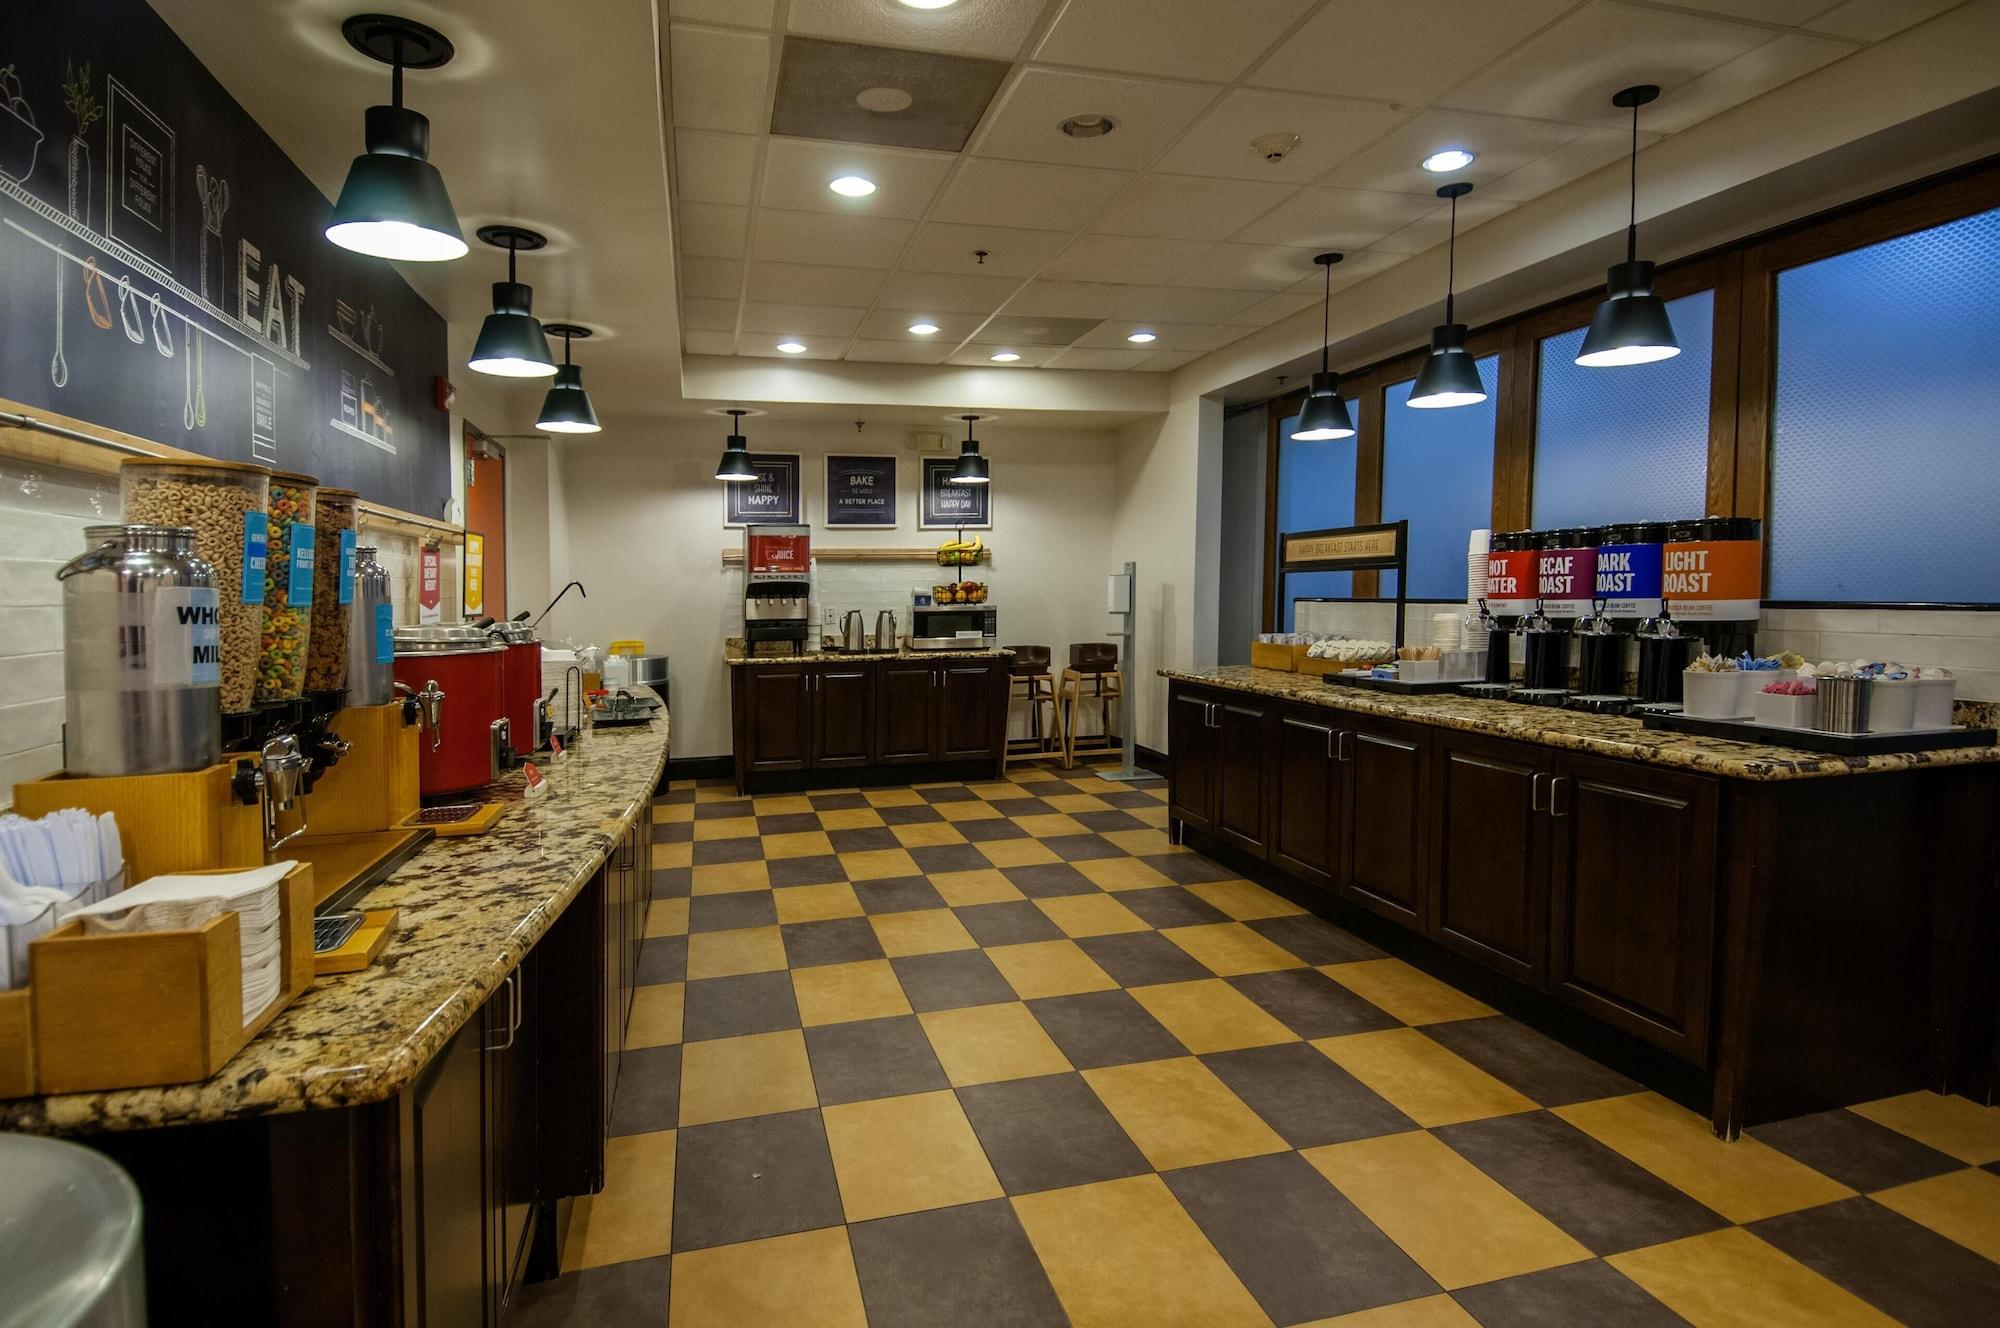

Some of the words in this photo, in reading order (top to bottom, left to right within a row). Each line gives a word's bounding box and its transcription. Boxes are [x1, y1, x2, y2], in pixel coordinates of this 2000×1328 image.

[238, 238, 306, 357] EAT
[850, 475, 874, 486] BAKE
[748, 495, 779, 505] HAPPY
[940, 488, 972, 498] BREAKFAST
[940, 499, 960, 509] HAPPY
[960, 499, 972, 509] DAY
[1315, 542, 1343, 554] BREAKFAST
[1344, 539, 1363, 553] STARTS
[1364, 538, 1379, 551] HERE
[776, 549, 794, 560] JUICE
[1597, 552, 1631, 572] DARK
[1665, 550, 1709, 571] LIGHT
[1488, 576, 1517, 594] ATER
[1663, 572, 1712, 593] ROAST
